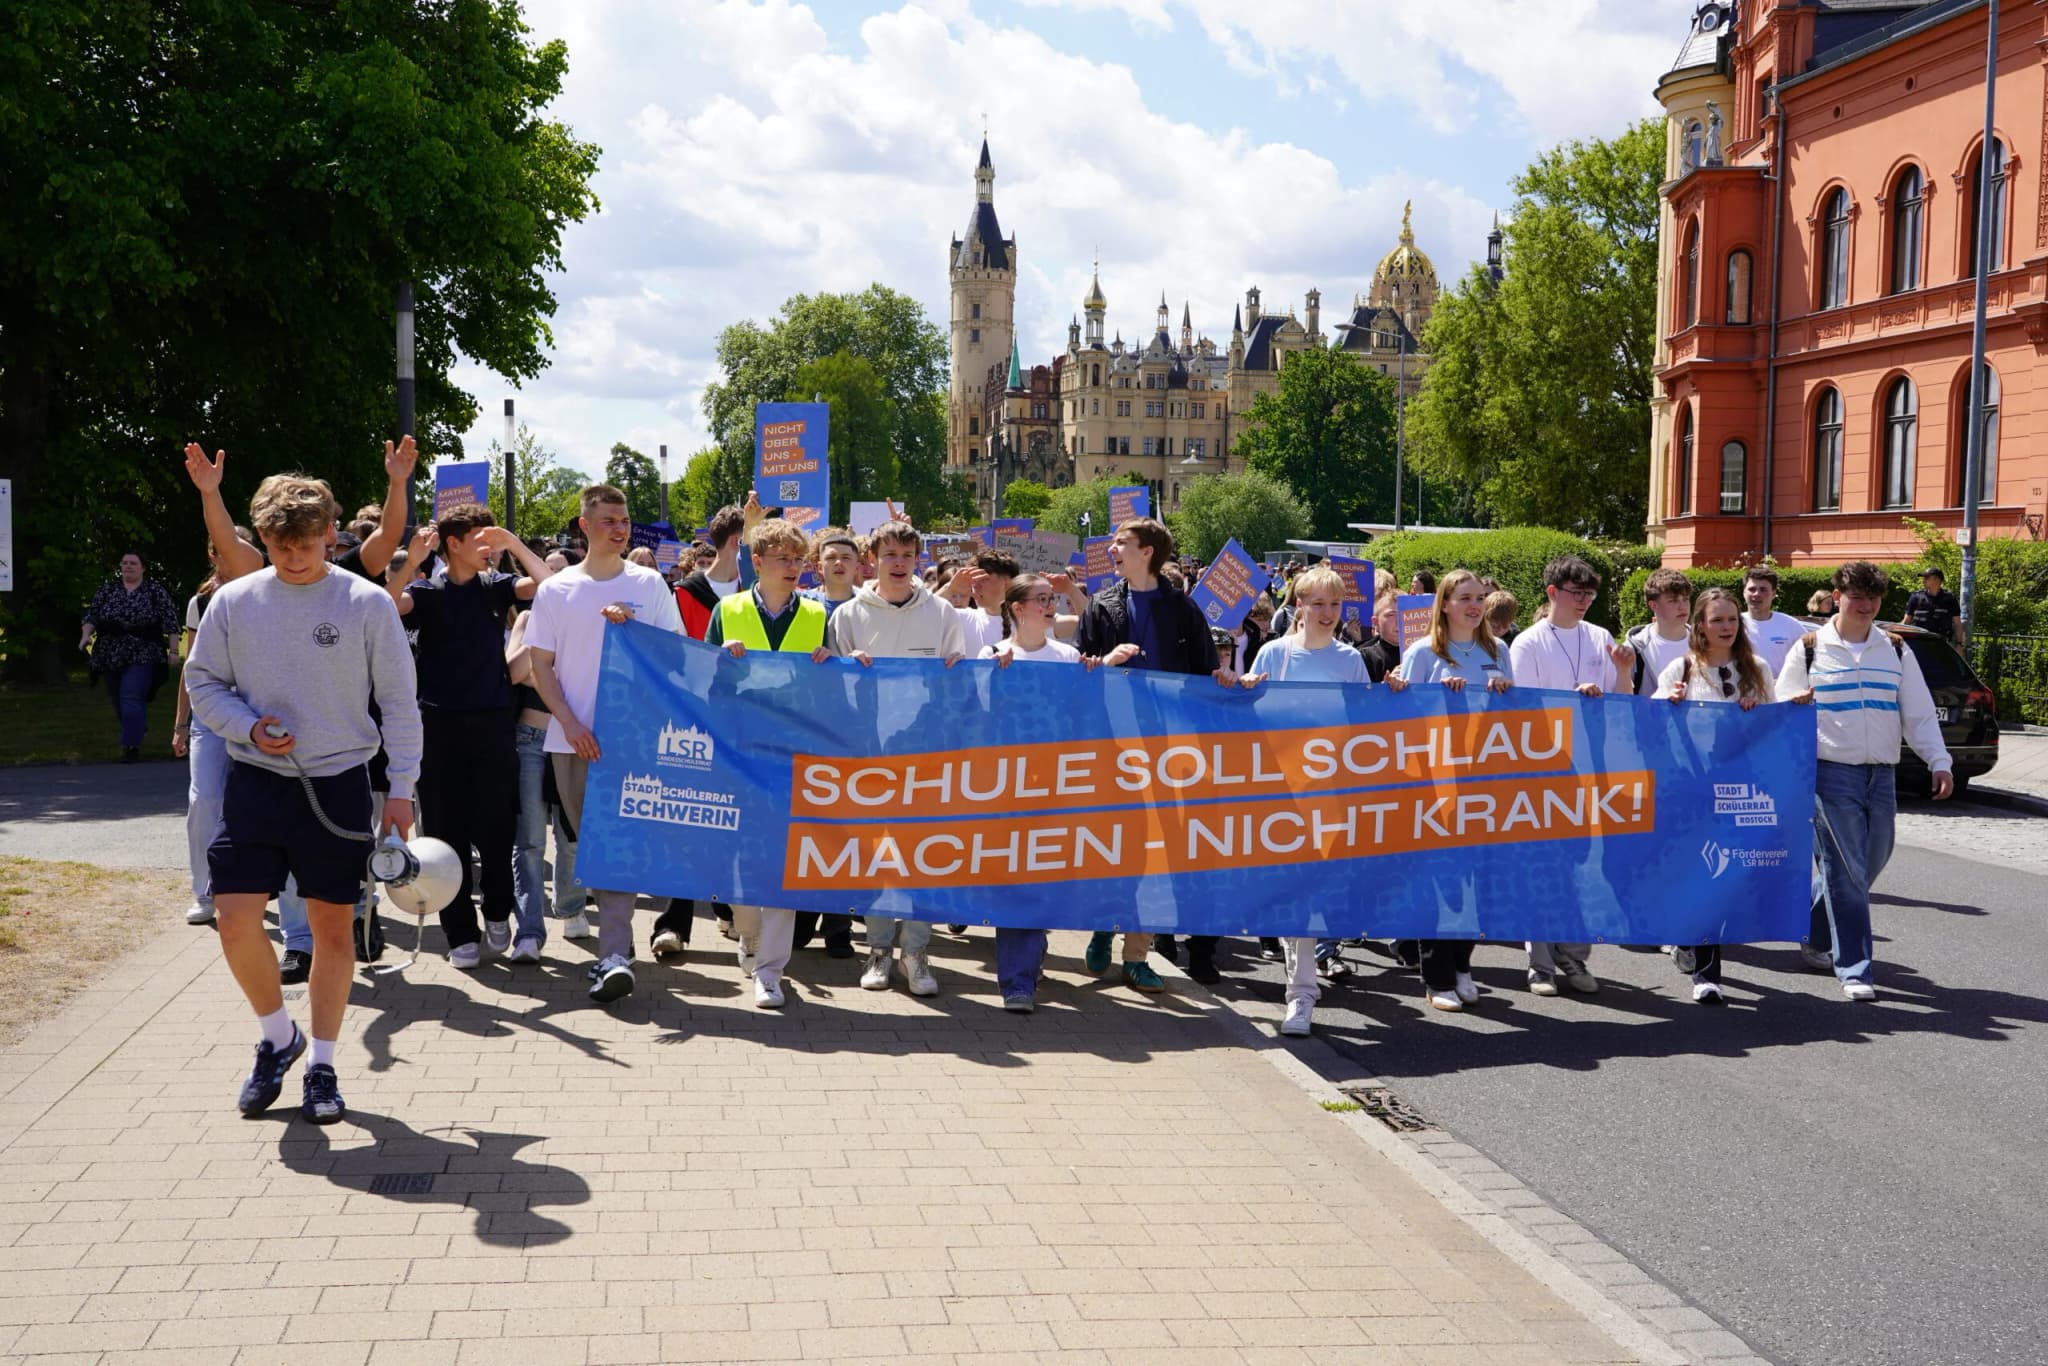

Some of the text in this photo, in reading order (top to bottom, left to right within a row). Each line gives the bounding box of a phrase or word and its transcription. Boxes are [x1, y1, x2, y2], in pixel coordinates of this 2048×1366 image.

[764, 423, 804, 436] NICHT
[764, 450, 790, 461] UNS
[763, 460, 817, 474] MIT UNS!
[439, 487, 473, 497] MATHE
[1224, 552, 1249, 578] MAKE
[1333, 563, 1366, 572] BILDUNG
[1212, 570, 1241, 597] GREAT
[1217, 562, 1256, 598] BILDUNG
[1404, 623, 1427, 633] BILD
[666, 737, 707, 761] LSR
[801, 719, 1563, 806] SCHULE SOLL SCHLAU
[624, 782, 735, 804] STADT SCHÜLERRAT
[1716, 786, 1742, 795] STADT
[1717, 800, 1770, 811] SCHÜLERRAT
[622, 797, 737, 828] SCHWERIN
[1740, 815, 1774, 824] ROSTOCK
[797, 782, 1643, 878] MACHEN - NICHT KRANK!
[1732, 848, 1788, 859] Förderverein
[1742, 859, 1756, 867] LSR
[1758, 859, 1770, 867] M-V
